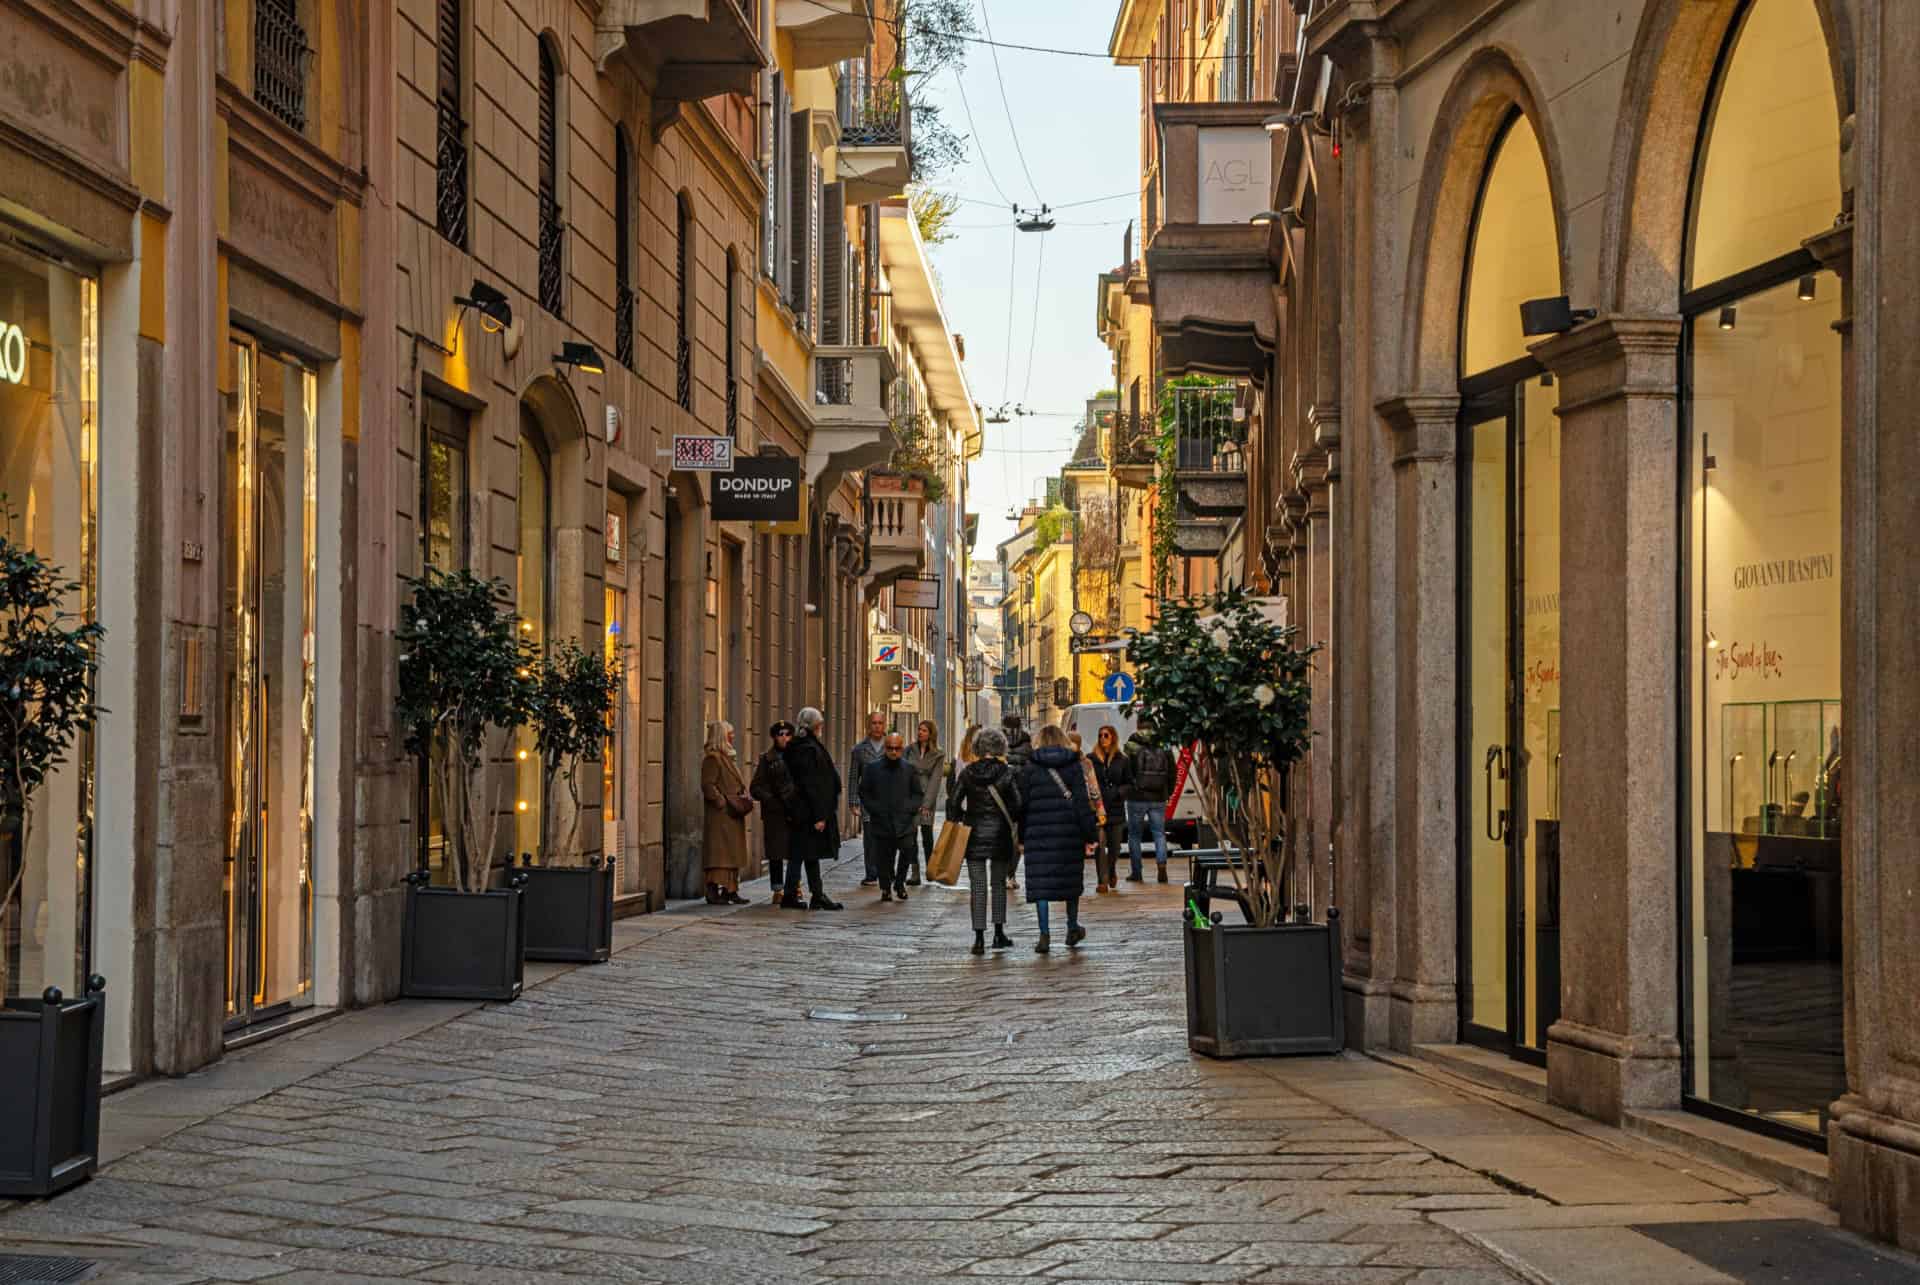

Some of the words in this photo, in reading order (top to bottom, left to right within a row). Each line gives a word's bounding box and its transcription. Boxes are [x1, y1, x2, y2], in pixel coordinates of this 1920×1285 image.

[1203, 159, 1265, 185] AGL
[716, 443, 727, 458] 2
[719, 477, 792, 492] DONDUP
[1734, 559, 1785, 590] GIOVANNI
[1788, 553, 1833, 582] RASPINI
